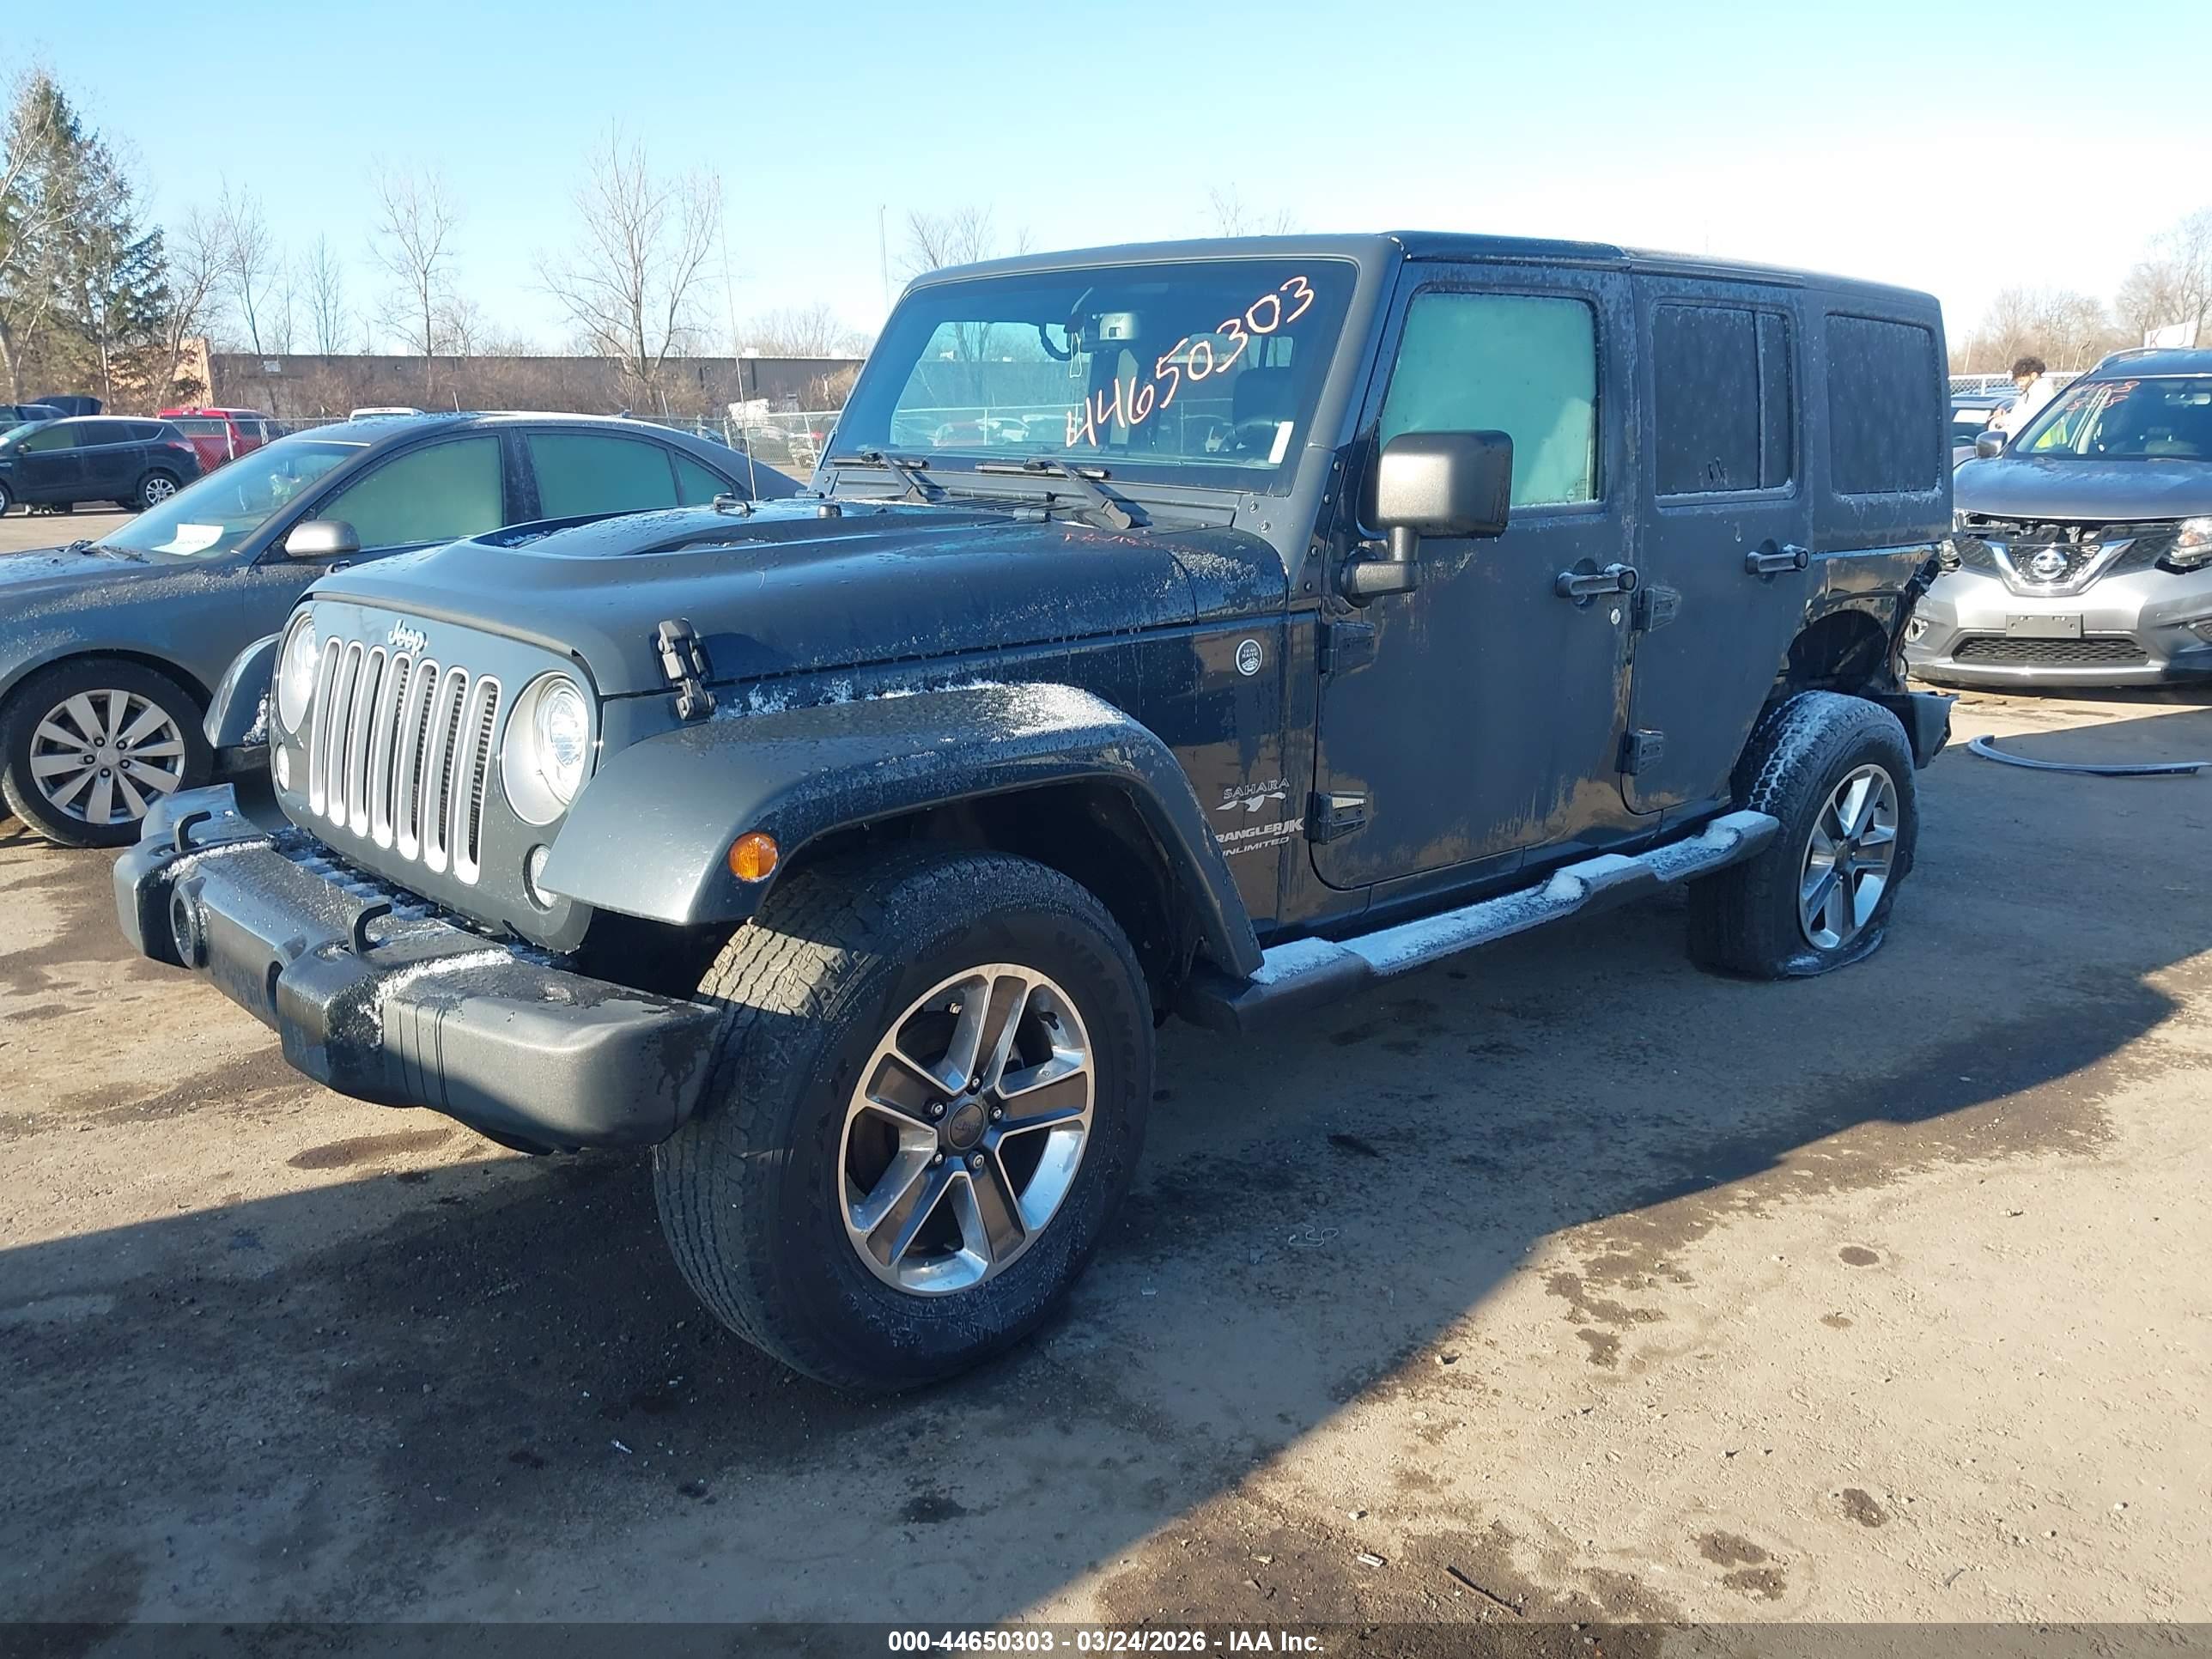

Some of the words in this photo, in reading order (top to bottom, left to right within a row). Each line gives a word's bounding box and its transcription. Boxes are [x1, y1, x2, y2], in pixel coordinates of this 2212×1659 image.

[1066, 276, 1315, 447] 44650303
[387, 618, 428, 658] Jeep
[1223, 777, 1290, 799] SAHARA
[1215, 823, 1284, 843] RANGLER
